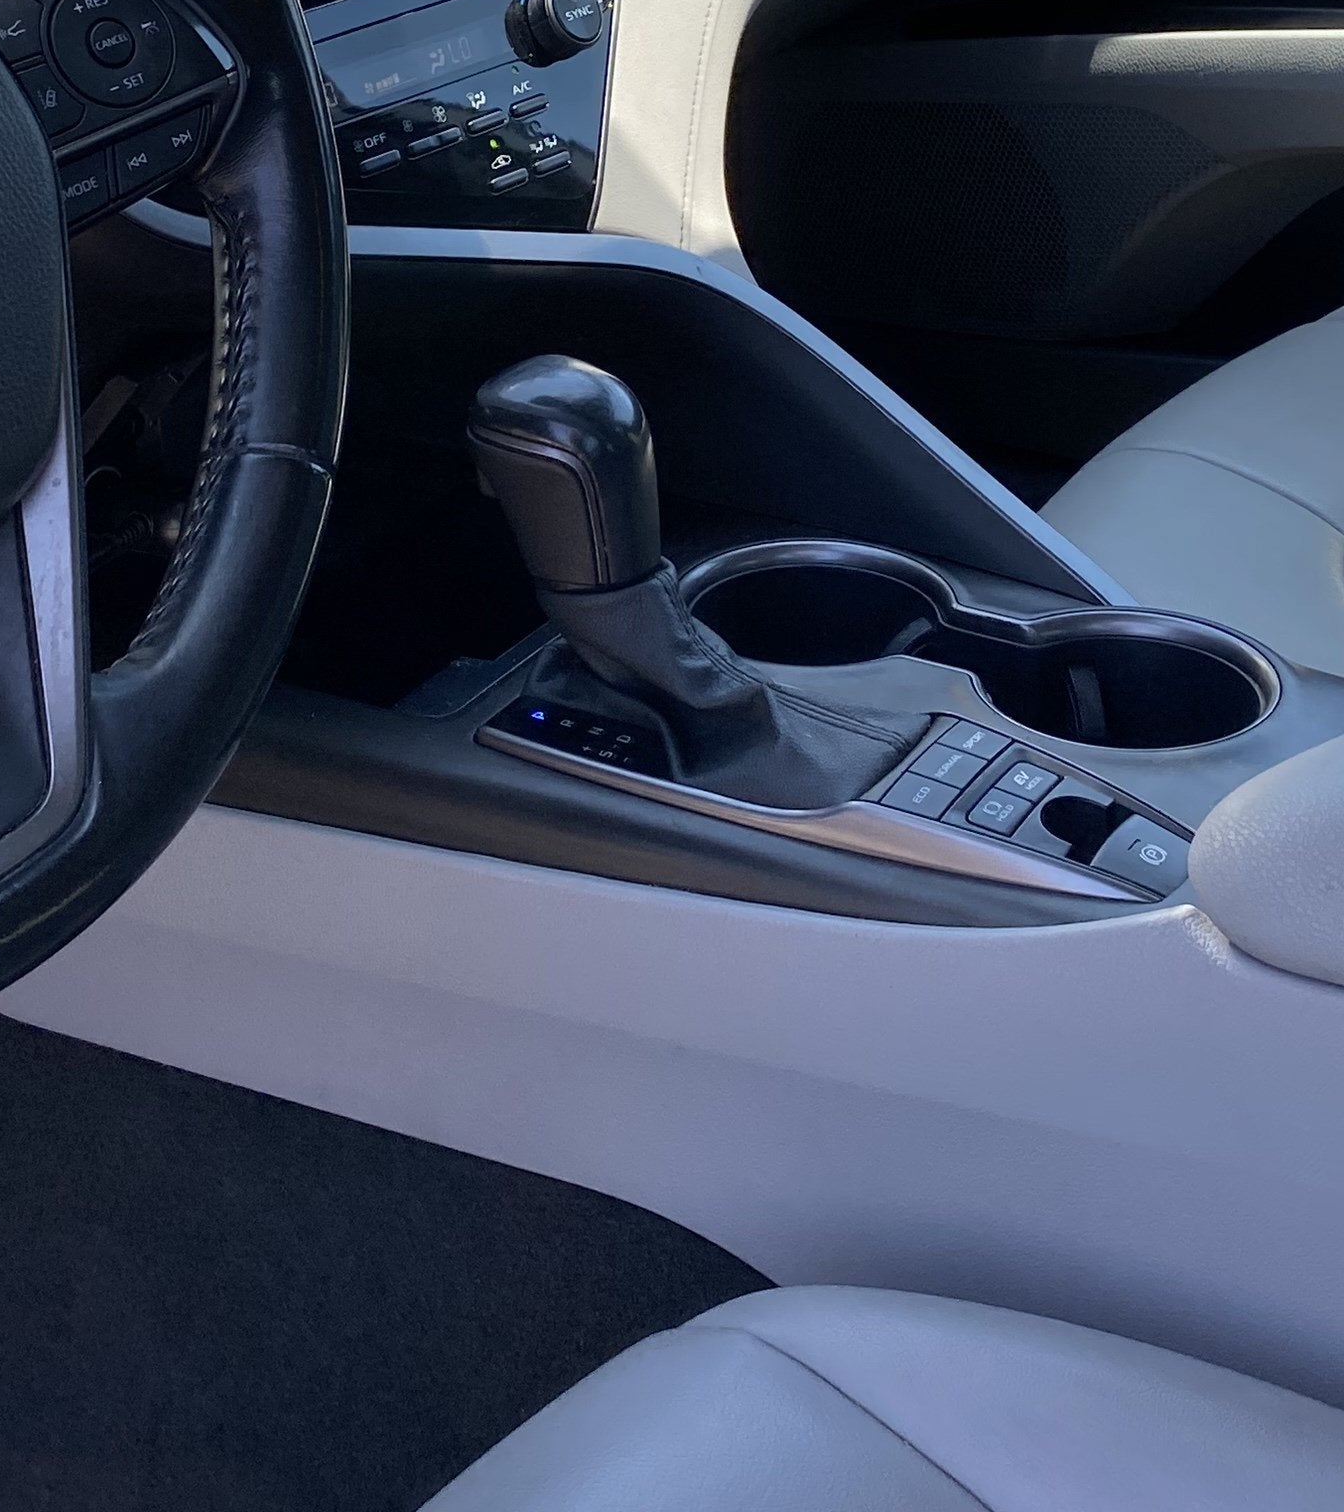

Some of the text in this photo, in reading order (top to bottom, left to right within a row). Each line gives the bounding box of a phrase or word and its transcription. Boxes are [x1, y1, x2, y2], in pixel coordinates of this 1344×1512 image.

[565, 4, 594, 22] SYNC
[95, 33, 129, 51] CANCEL
[511, 80, 533, 95] A/C
[364, 132, 387, 149] OFF
[62, 176, 99, 200] MODE
[962, 731, 985, 750] SPORT
[934, 752, 963, 780] NORMAL
[1013, 770, 1029, 786] EV
[912, 786, 931, 805] ECO
[996, 803, 1015, 822] HOLD
